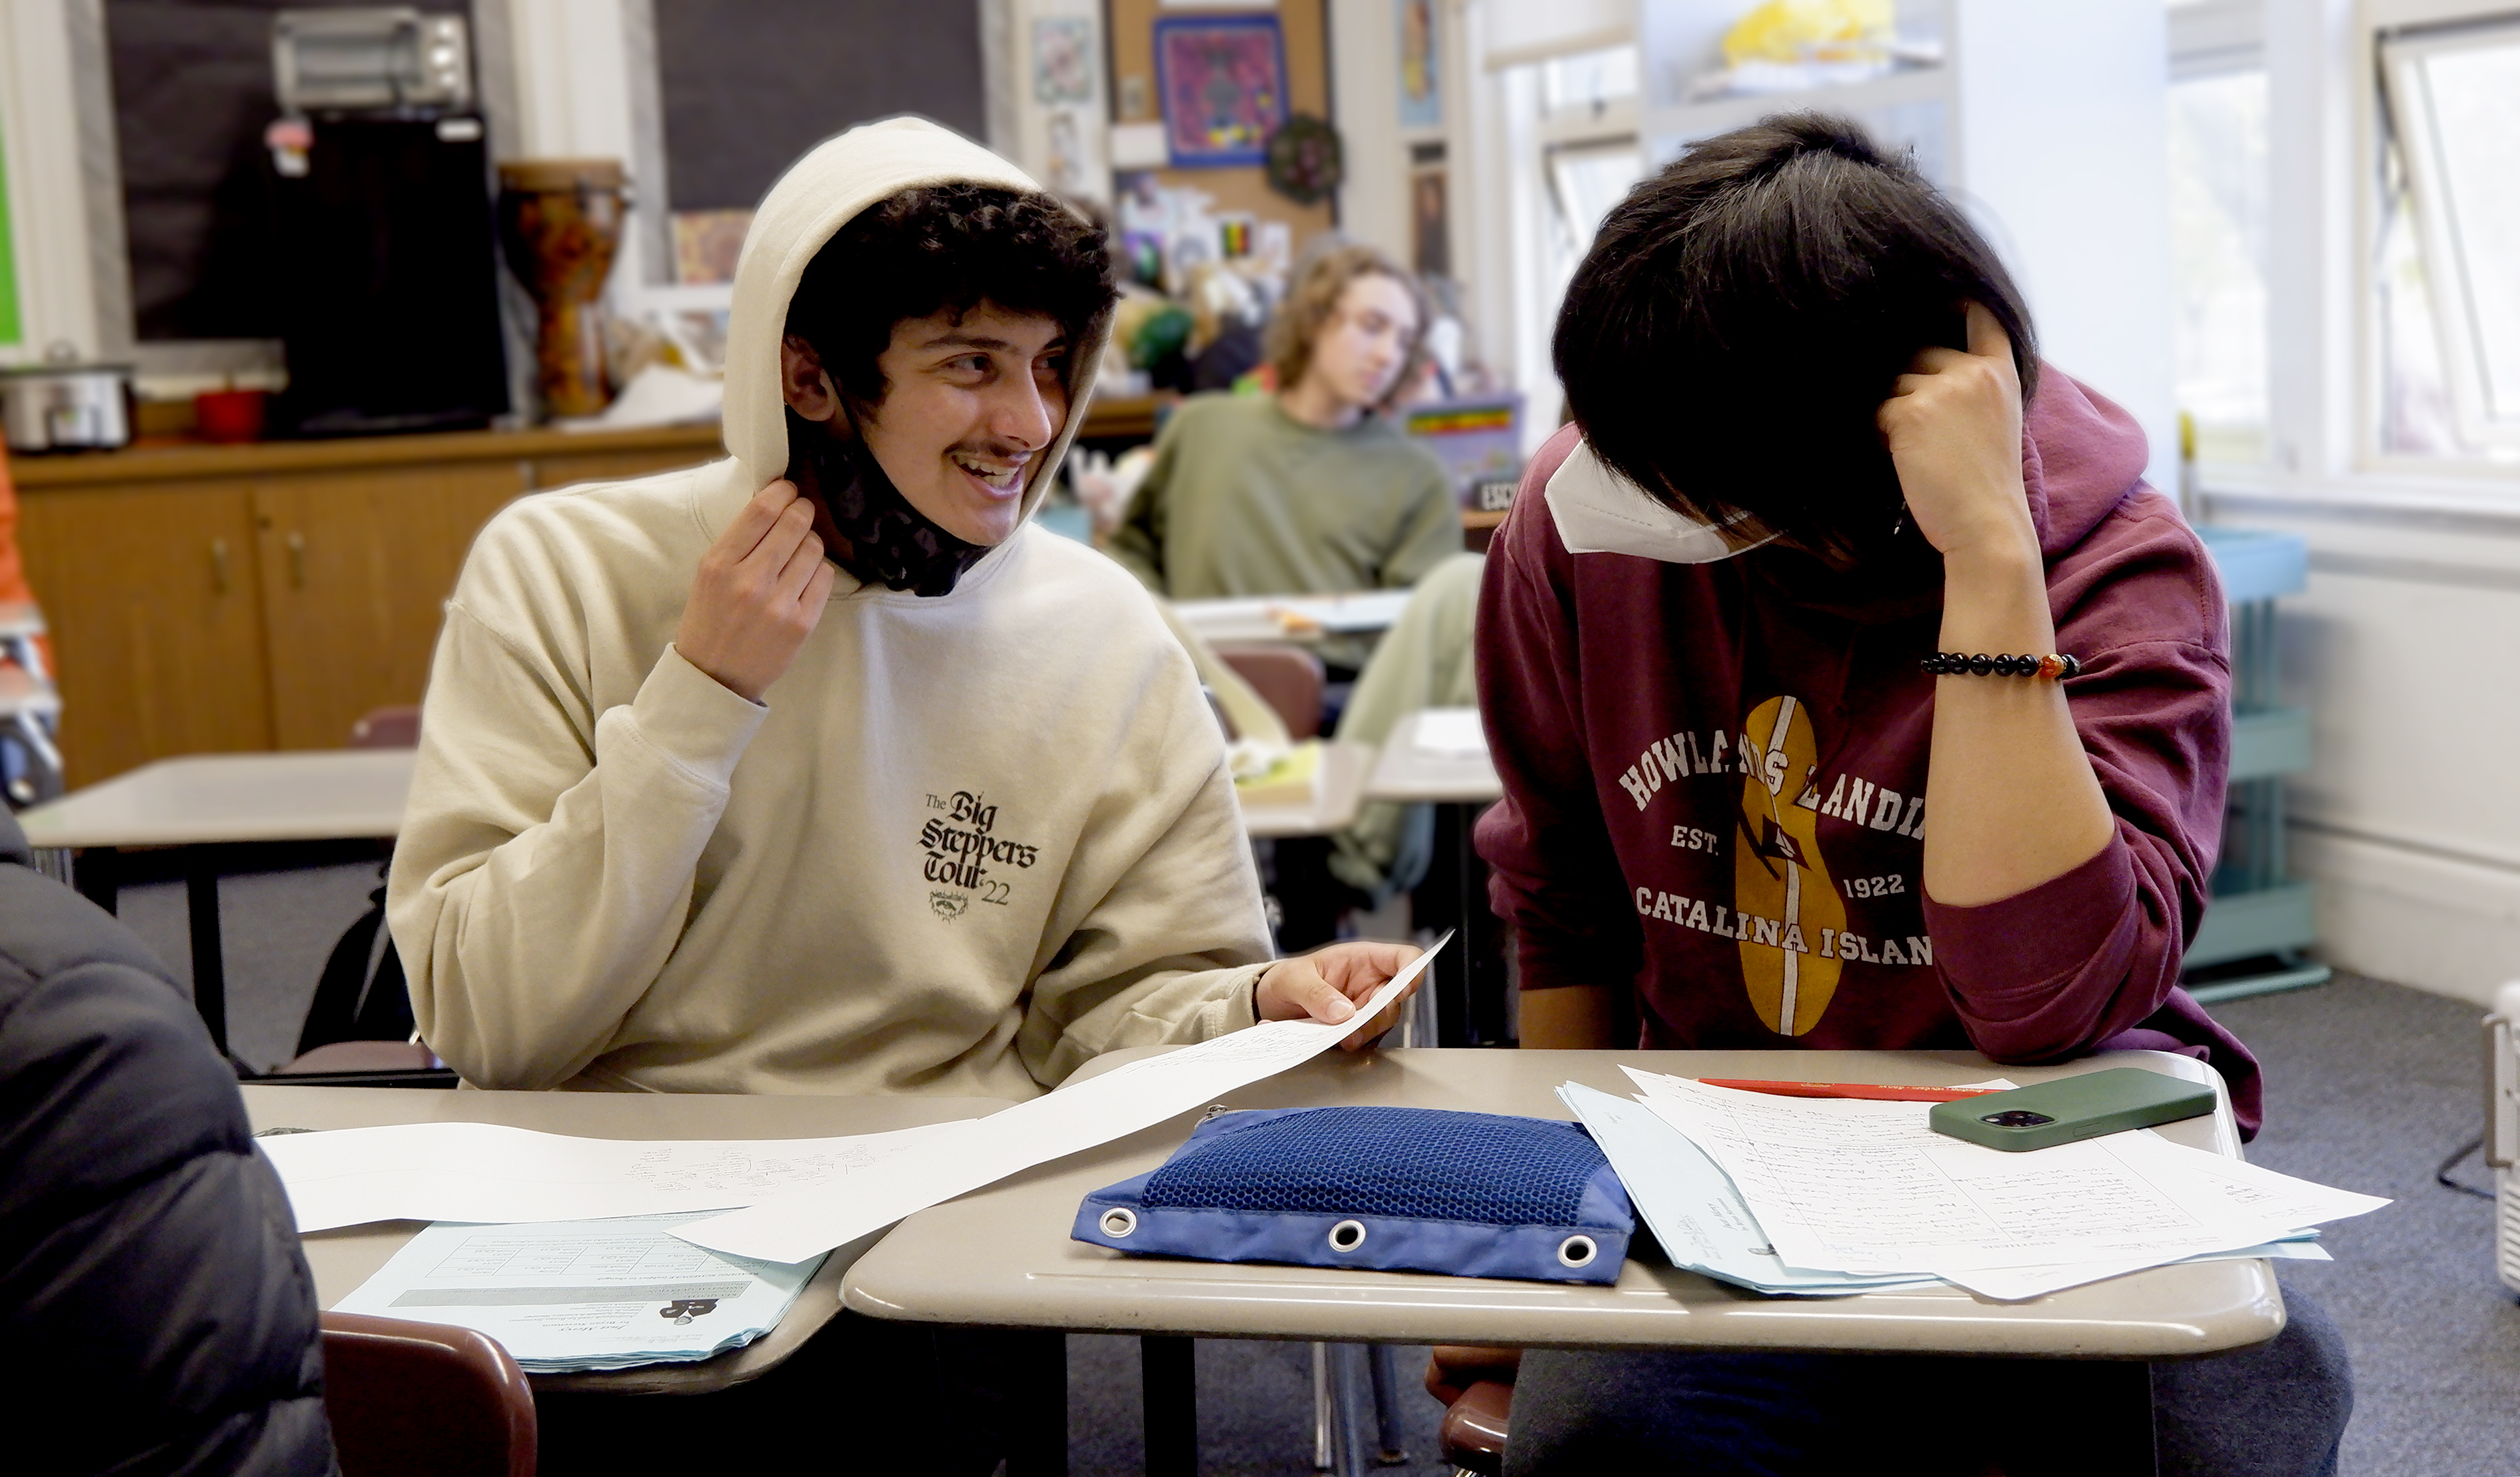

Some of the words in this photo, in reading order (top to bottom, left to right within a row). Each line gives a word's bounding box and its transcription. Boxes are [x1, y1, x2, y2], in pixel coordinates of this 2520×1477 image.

[925, 793, 947, 810] The
[945, 791, 999, 835] Big
[916, 817, 1041, 868] Steppers
[1671, 825, 1719, 856] EST.
[924, 850, 987, 889] Tour
[1843, 874, 1905, 898] 1922
[1636, 885, 1809, 953] CATALINA
